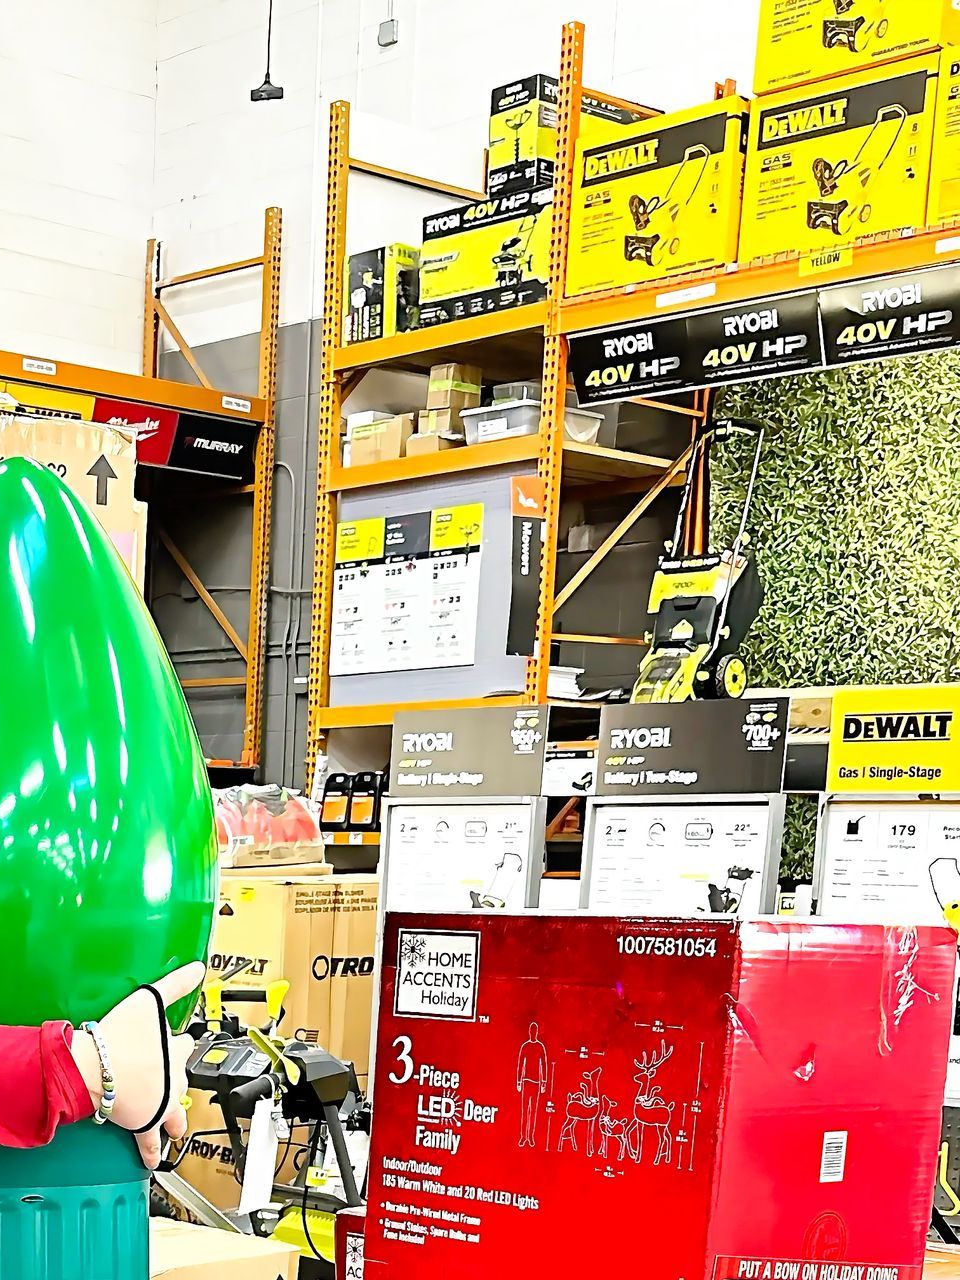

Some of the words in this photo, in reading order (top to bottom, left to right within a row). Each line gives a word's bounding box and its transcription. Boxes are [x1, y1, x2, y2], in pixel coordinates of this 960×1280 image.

[762, 153, 791, 166] GAS
[463, 200, 499, 222] 40V
[500, 192, 530, 212] HP
[586, 190, 610, 202] GAS
[811, 253, 840, 268] YELLOW
[861, 282, 922, 314] RYOBI
[723, 308, 778, 336] RYOBI
[836, 319, 897, 346] 40V
[902, 310, 952, 335] HP
[602, 332, 653, 358] RYOBI
[702, 342, 758, 368] 40V
[762, 335, 808, 358] HP
[585, 362, 634, 388] 40V
[640, 356, 680, 378] HP
[520, 521, 533, 576] Mowers
[402, 732, 453, 753] RYOBI
[610, 726, 671, 750] RYOBI
[603, 770, 639, 787] Battery
[645, 769, 698, 786] Two-Stage
[839, 767, 859, 778] Gas
[870, 766, 942, 780] Single-Stage
[891, 825, 916, 836] 179
[616, 936, 717, 958] 1007581054
[428, 952, 472, 968] HOME
[402, 971, 471, 989] ACCENTS
[421, 990, 469, 1011] Holiday
[418, 1094, 455, 1119] LED
[463, 1099, 498, 1124] Deer
[415, 1124, 461, 1154] Family
[383, 1156, 442, 1176] Indoor/Outdoor
[382, 1174, 396, 1187] 185
[397, 1176, 420, 1191] Warm
[422, 1180, 445, 1195] White
[447, 1185, 463, 1197] and
[464, 1186, 475, 1199] 20
[477, 1187, 493, 1202] Red
[495, 1190, 511, 1204] LED
[513, 1193, 539, 1210] Lights
[738, 1259, 761, 1278] PUT
[763, 1262, 772, 1280] A
[774, 1263, 800, 1280] BOW
[802, 1265, 818, 1280] ON
